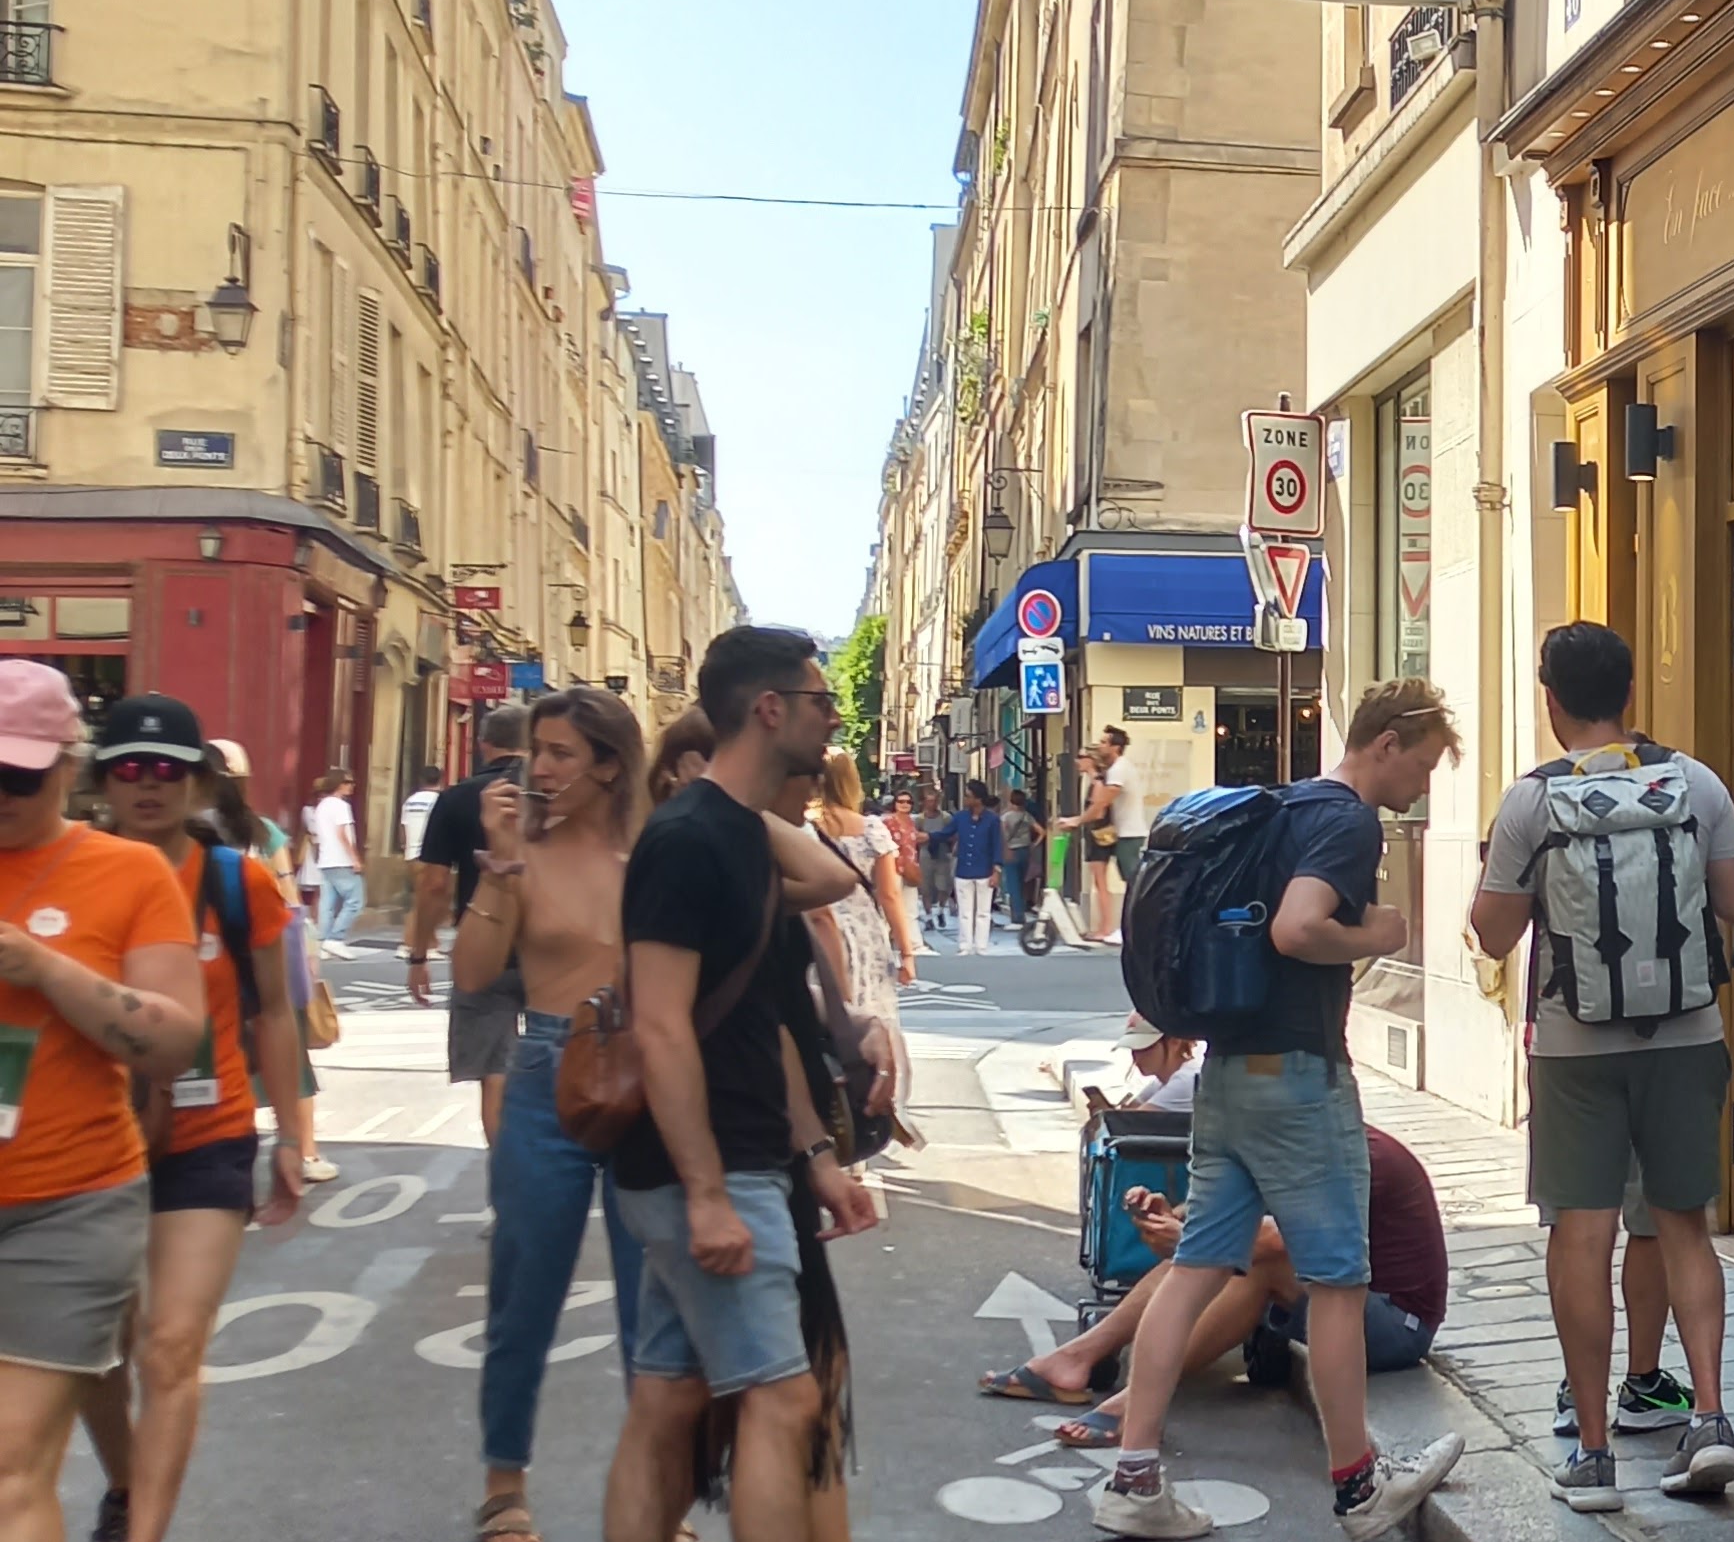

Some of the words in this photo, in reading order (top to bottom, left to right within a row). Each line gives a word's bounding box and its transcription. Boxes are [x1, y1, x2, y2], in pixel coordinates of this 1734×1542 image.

[1262, 427, 1309, 449] ZONE
[1274, 477, 1298, 498] 30
[1147, 623, 1176, 640] VINS
[1177, 624, 1228, 641] NATURES
[1230, 626, 1244, 641] ET
